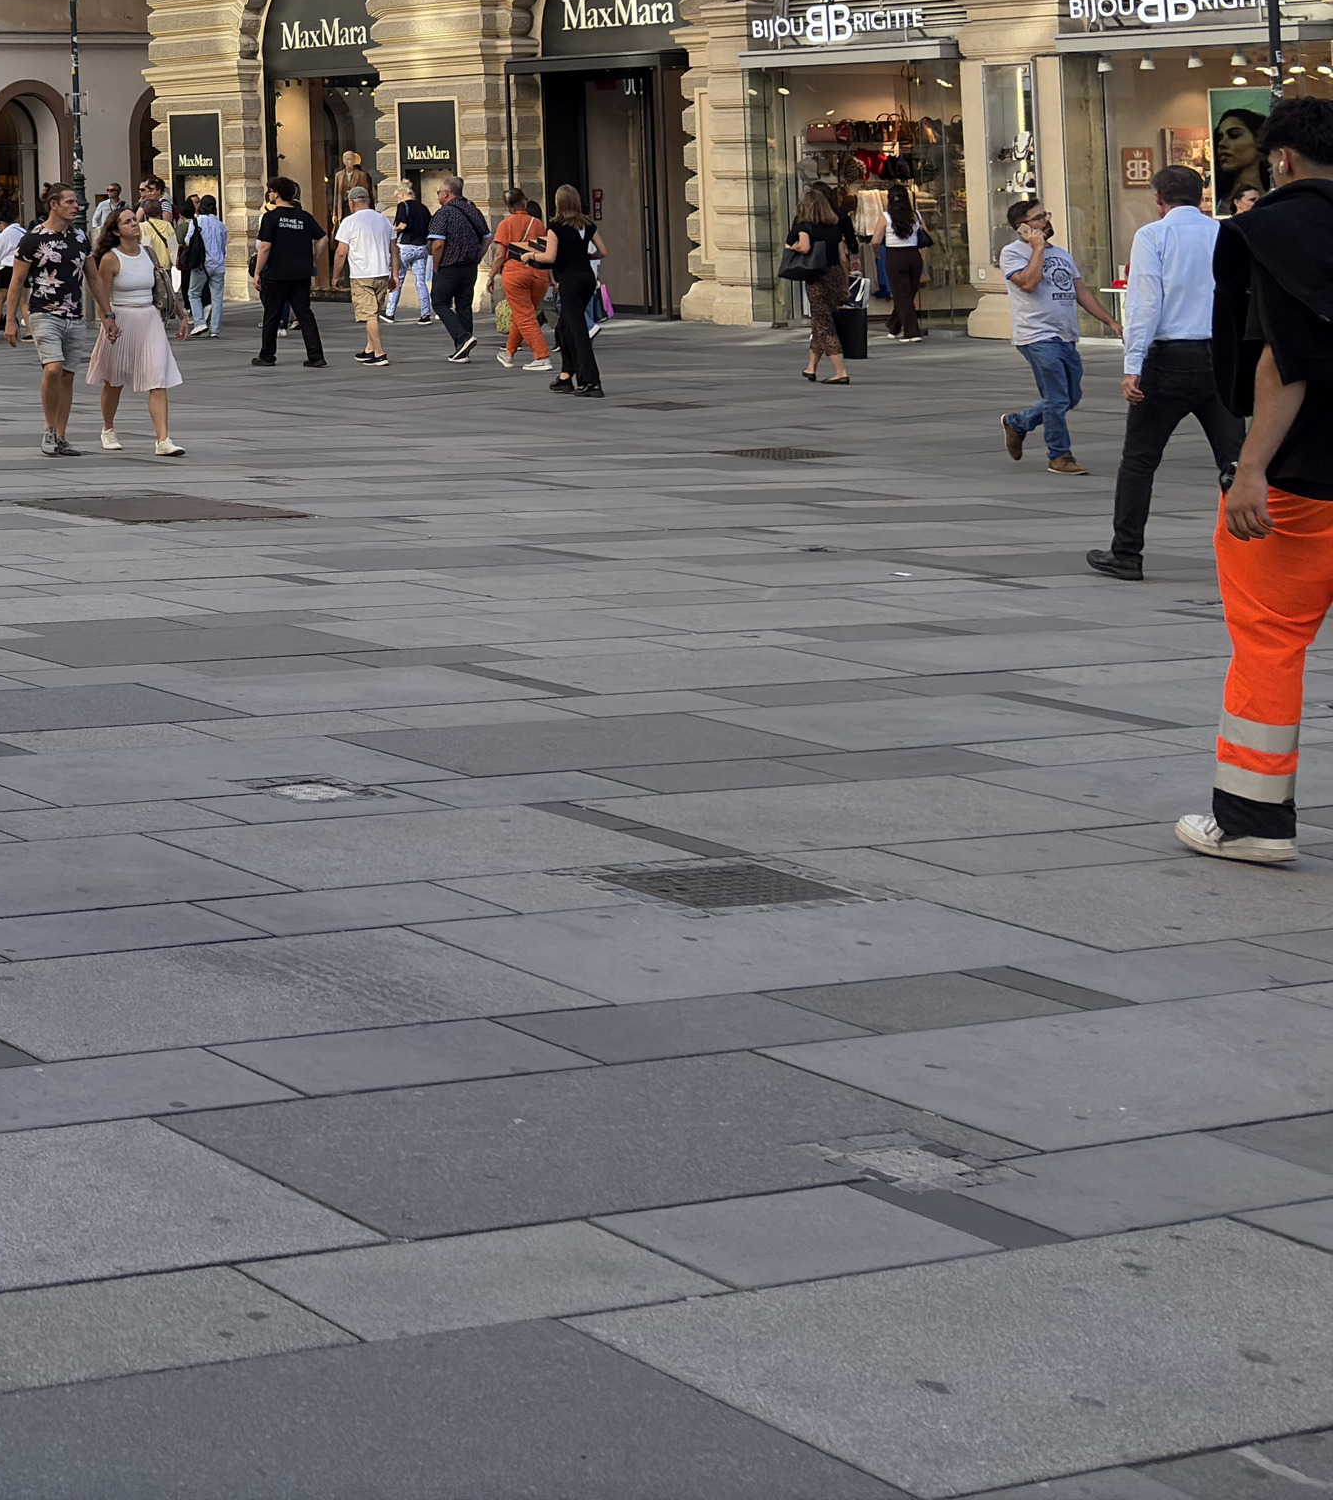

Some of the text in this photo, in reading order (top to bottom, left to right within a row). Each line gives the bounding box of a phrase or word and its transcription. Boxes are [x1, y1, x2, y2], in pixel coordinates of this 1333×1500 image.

[280, 17, 368, 51] MaxMara
[752, 16, 804, 42] BIJOU
[178, 153, 213, 167] MaxMara
[406, 145, 450, 160] MaxMara
